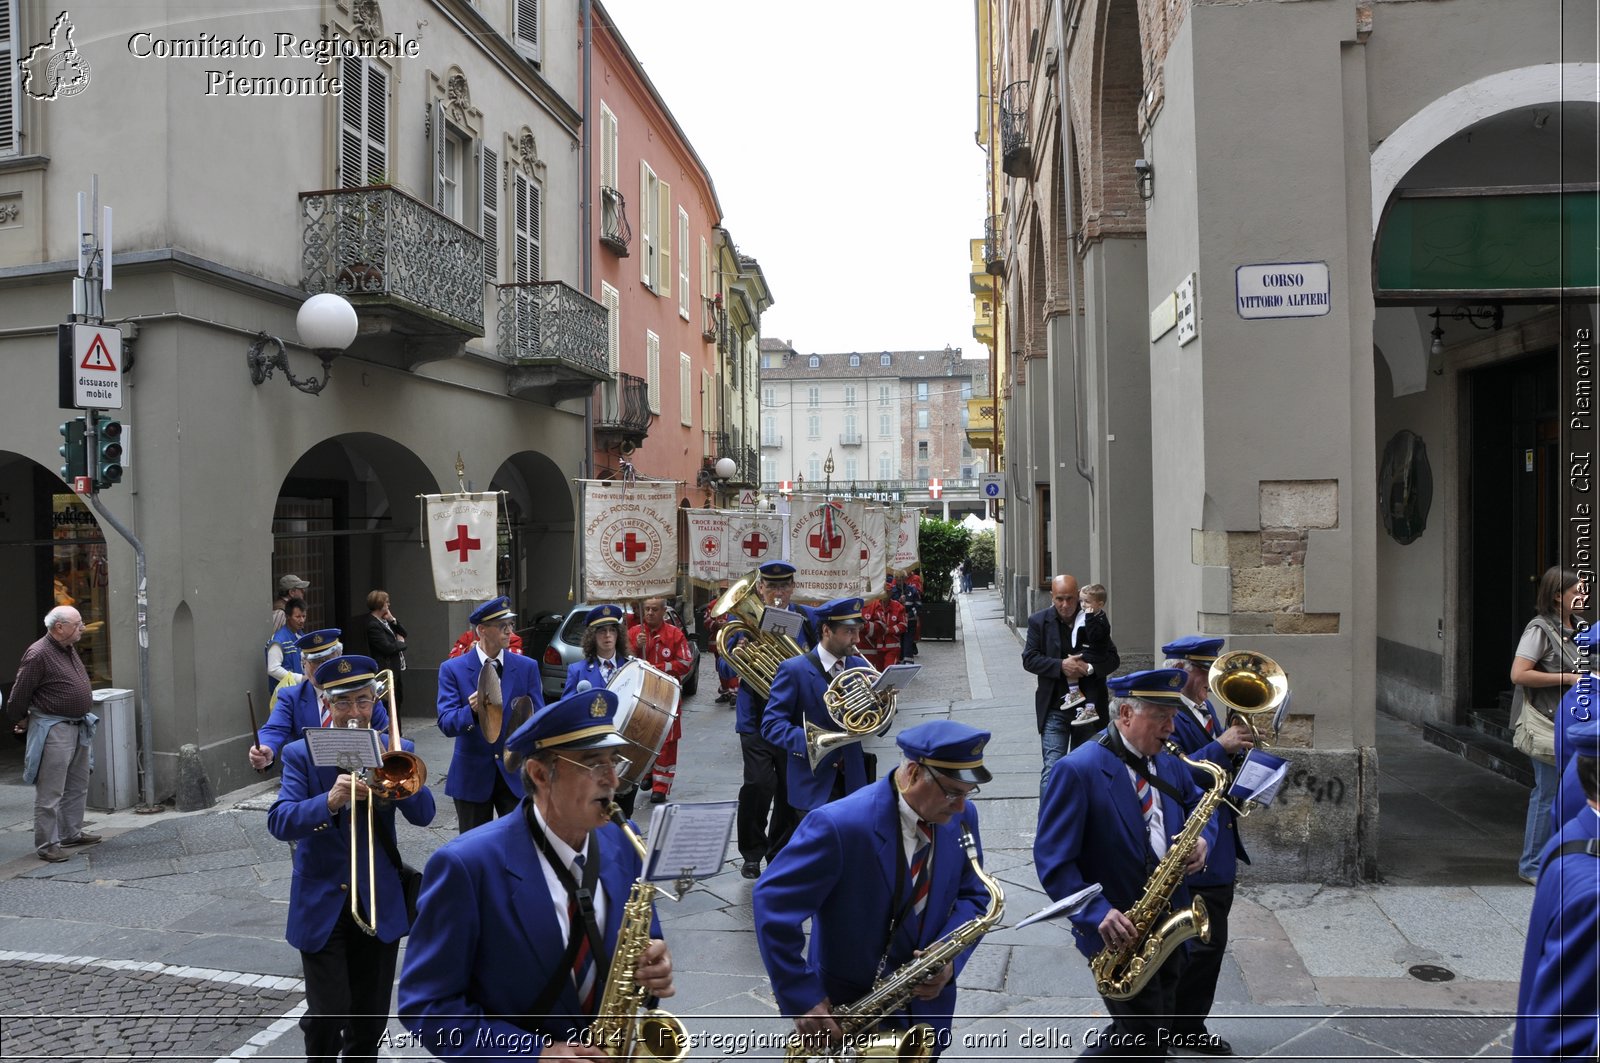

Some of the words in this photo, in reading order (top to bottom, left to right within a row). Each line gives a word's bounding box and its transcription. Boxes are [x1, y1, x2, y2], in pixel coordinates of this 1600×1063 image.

[1262, 272, 1304, 288] CORSO
[1240, 294, 1283, 309] VITTORIO
[1286, 292, 1327, 307] ALFIERI
[79, 376, 119, 388] dissuasore
[86, 389, 112, 399] mobile
[609, 492, 635, 500] VOLOTARI
[586, 511, 609, 537] CROCE
[609, 504, 640, 514] ROSSA
[642, 506, 674, 538] ITALIANA
[792, 515, 809, 539] CROCE
[809, 508, 824, 518] ROS
[836, 511, 861, 541] ITALIANA
[800, 569, 840, 577] DELEGAZIONE
[587, 579, 624, 587] COMITATO
[626, 576, 675, 587] PROVINCIALE
